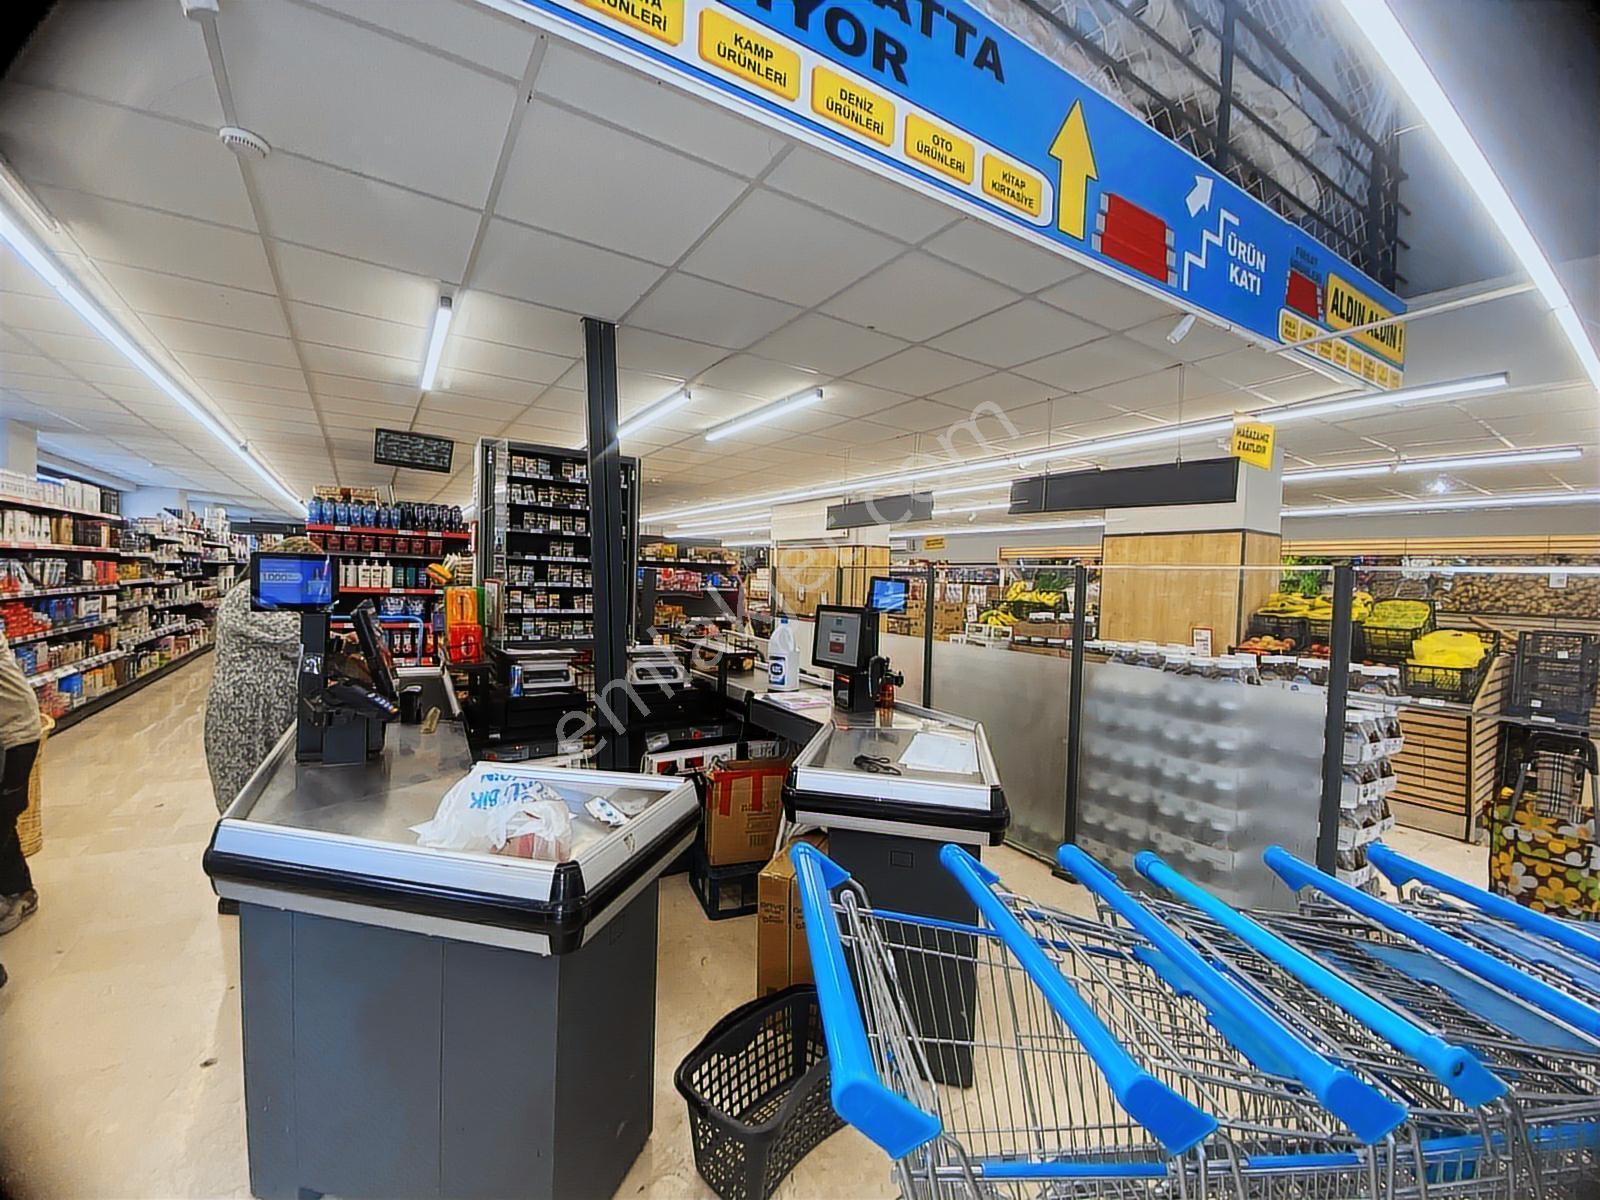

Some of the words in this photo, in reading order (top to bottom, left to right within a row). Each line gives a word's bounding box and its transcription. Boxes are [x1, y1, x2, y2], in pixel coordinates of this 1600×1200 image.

[733, 33, 774, 61] KAMP
[755, 0, 908, 86] YOR
[717, 41, 787, 87] ÜRÜNLERİ
[826, 97, 884, 135] ÜRÜNLERİ
[839, 88, 874, 114] DENİZ
[916, 141, 966, 174] ÜRÜNLERİ
[931, 134, 953, 152] OTO
[991, 180, 1034, 208] KIRTASİYE
[1002, 170, 1026, 189] KİTAP
[1227, 231, 1266, 273] ÜRÜN
[1229, 263, 1262, 296] KATI
[1330, 287, 1366, 327] ALDIN
